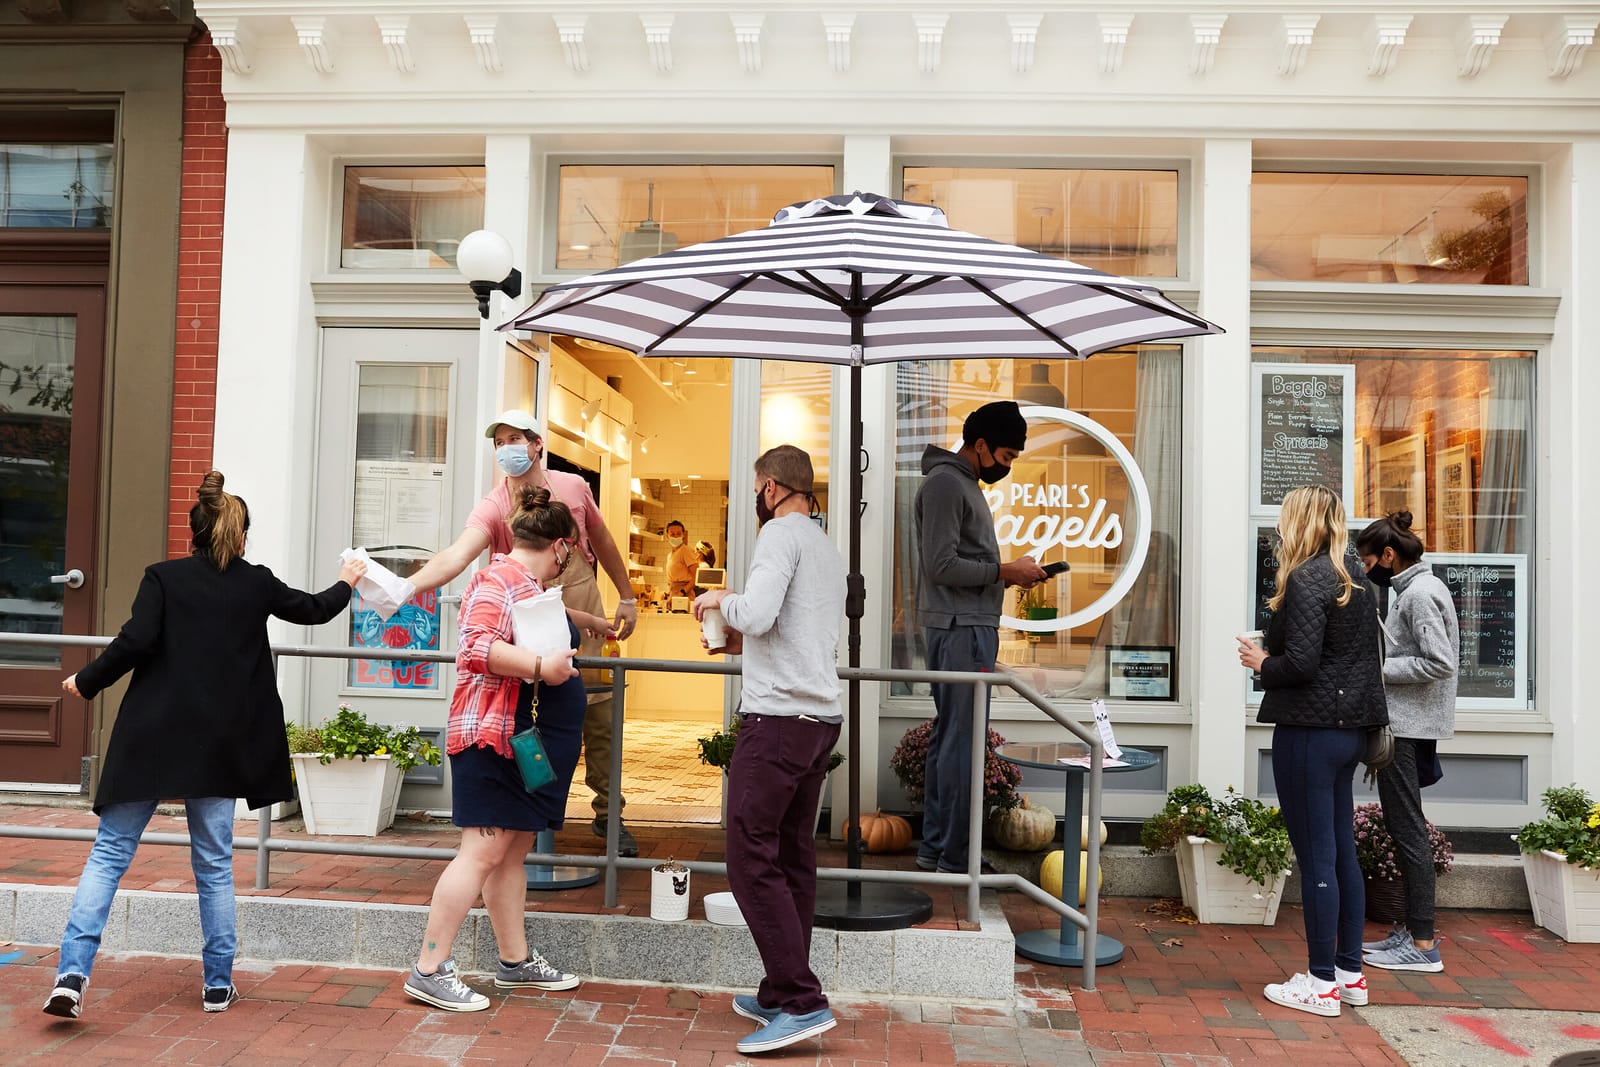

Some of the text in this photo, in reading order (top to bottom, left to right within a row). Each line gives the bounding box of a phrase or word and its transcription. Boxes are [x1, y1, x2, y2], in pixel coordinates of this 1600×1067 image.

[1272, 375, 1326, 399] Bagels
[1273, 432, 1328, 450] Spreads
[1010, 482, 1090, 508] PEARL'S
[1447, 566, 1499, 584] Drinks
[1461, 587, 1494, 597] Seltzer
[1470, 611, 1495, 619] Seltzer
[1478, 668, 1505, 678] Orange
